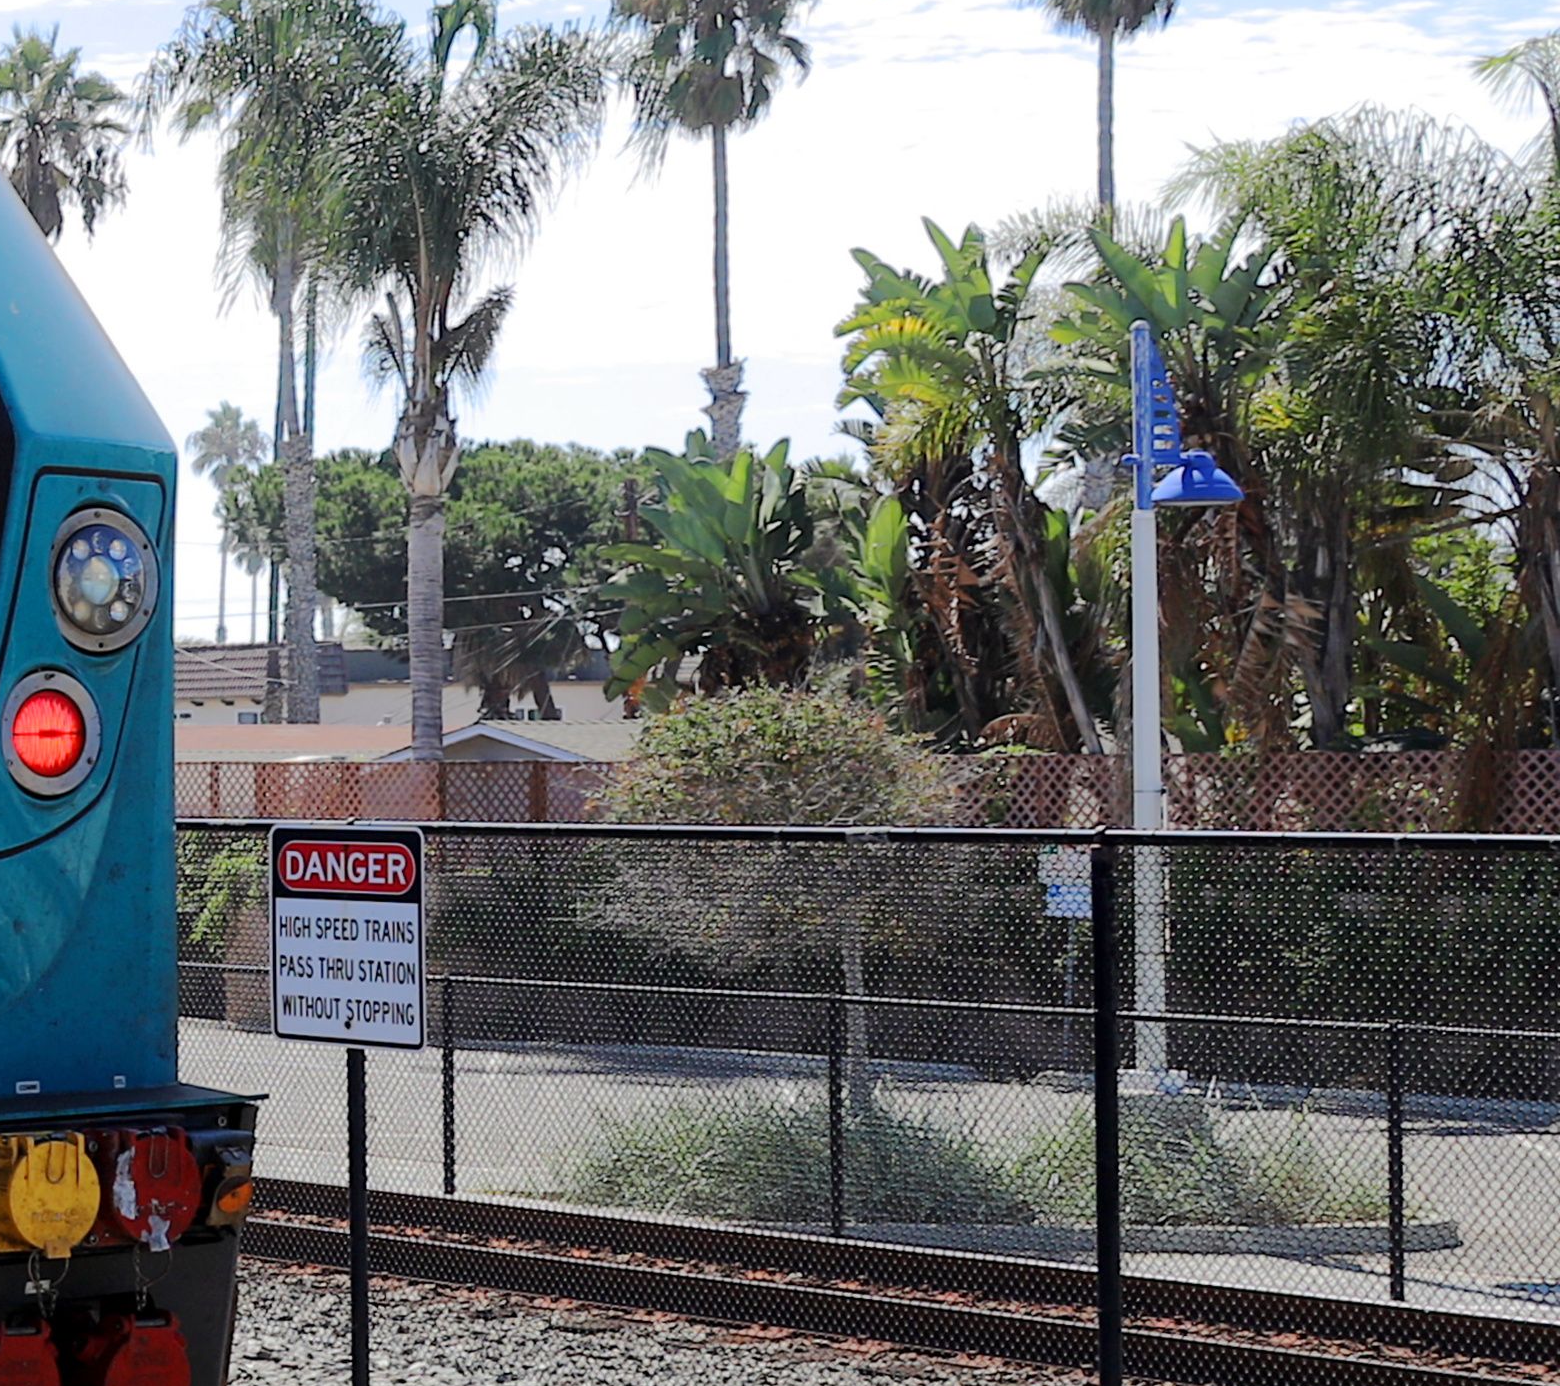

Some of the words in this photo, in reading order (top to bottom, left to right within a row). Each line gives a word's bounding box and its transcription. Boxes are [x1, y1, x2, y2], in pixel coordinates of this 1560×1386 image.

[285, 850, 407, 885] DANGER
[279, 915, 311, 939] HIGH
[315, 918, 359, 941] SPEED
[365, 919, 415, 945] TRAINS
[279, 954, 314, 979] PASS
[319, 957, 354, 982] THRU
[359, 959, 416, 986] STATION
[282, 994, 341, 1021] WITHOUT
[346, 999, 415, 1026] STOPPING
